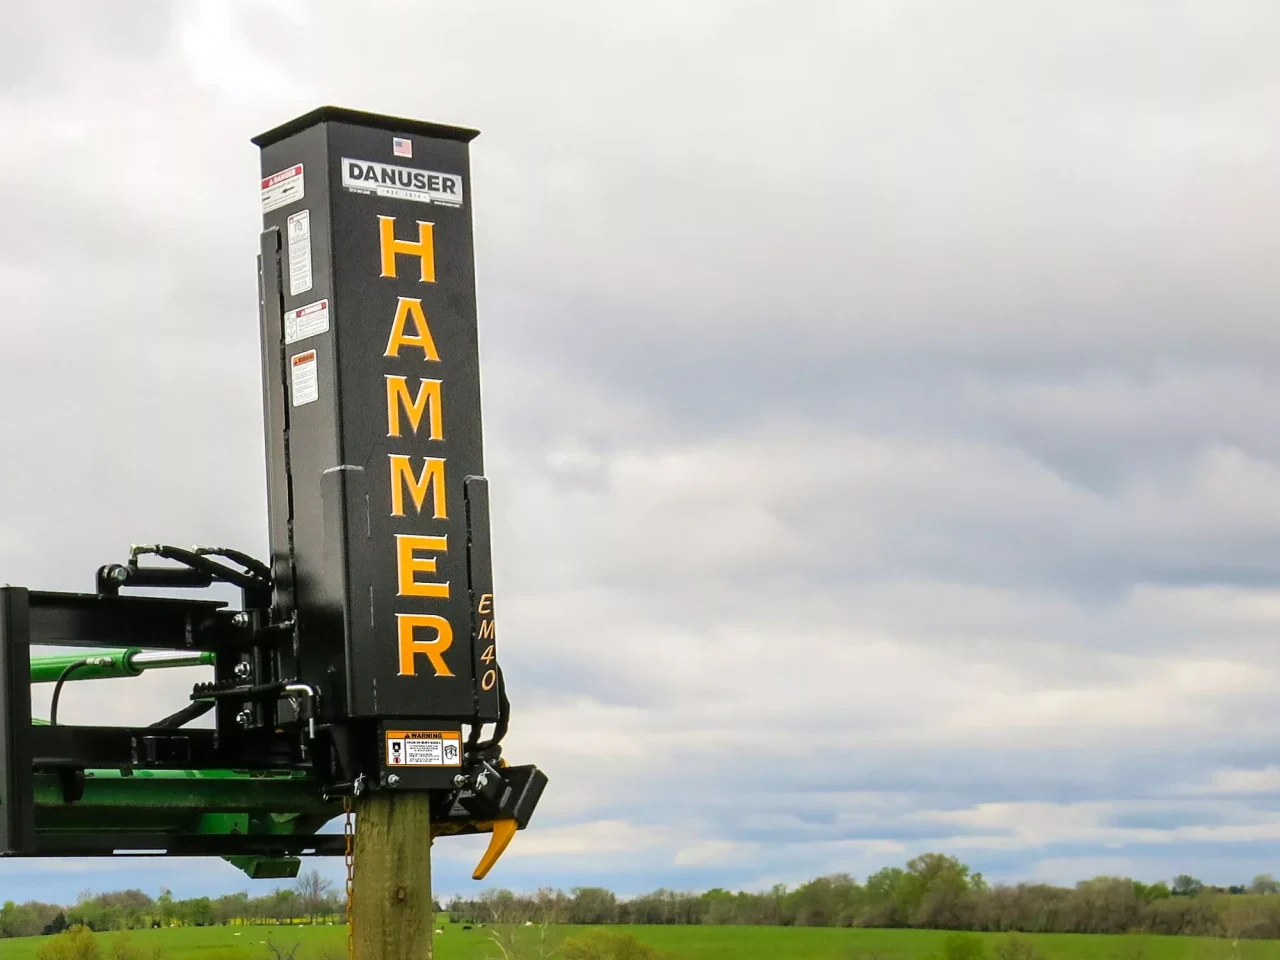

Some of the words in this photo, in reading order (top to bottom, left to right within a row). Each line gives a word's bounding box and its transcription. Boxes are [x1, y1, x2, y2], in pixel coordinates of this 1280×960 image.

[348, 162, 456, 195] DANUSER
[376, 214, 456, 677] HAMMER
[478, 593, 496, 691] EM40
